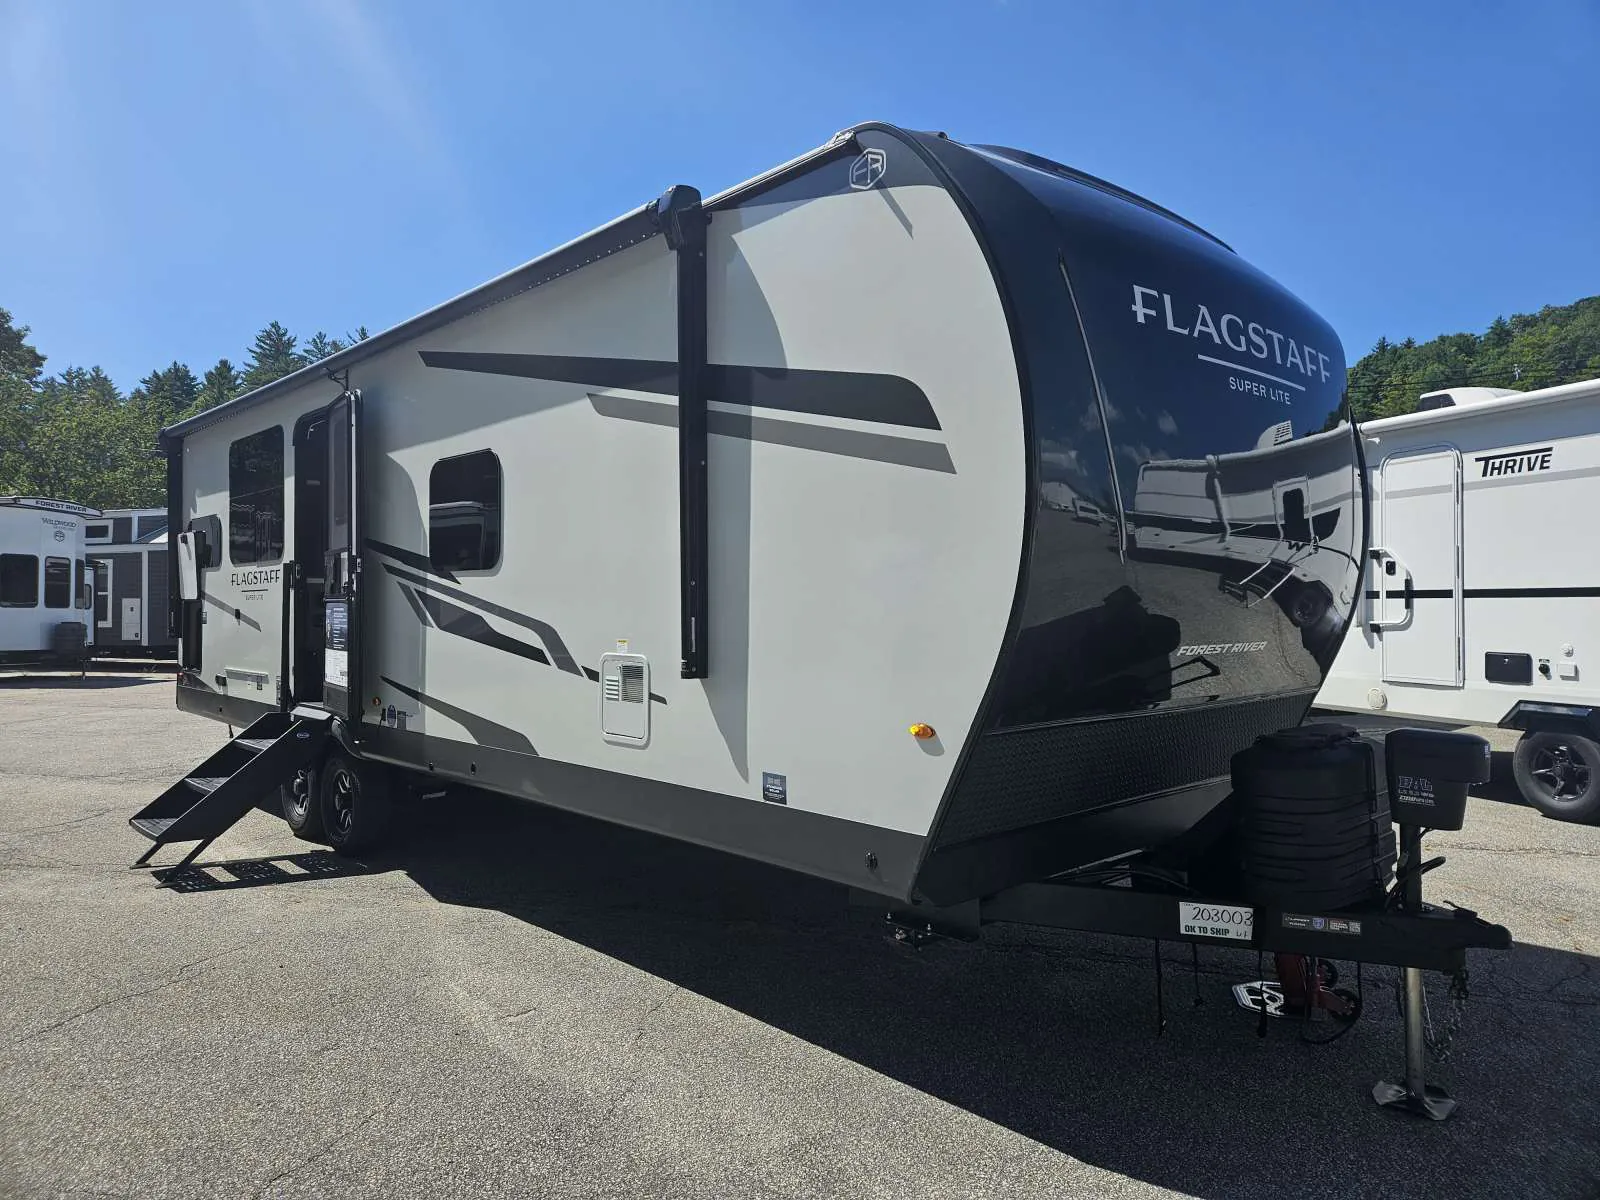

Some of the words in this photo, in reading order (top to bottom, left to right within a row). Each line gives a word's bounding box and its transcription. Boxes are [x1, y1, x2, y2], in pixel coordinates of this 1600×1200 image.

[1132, 284, 1331, 383] FLAGSTAFF
[1229, 376, 1267, 399] SUPER
[1270, 387, 1291, 405] LITE
[1474, 446, 1554, 478] THRIVE
[36, 500, 64, 509] FOREST
[65, 504, 87, 512] RIVER
[231, 569, 281, 586] FLAGSTAFF
[1176, 643, 1233, 657] FOREST
[1230, 641, 1268, 653] RIVER
[1192, 906, 1254, 927] 203003
[1184, 924, 1196, 934] OK
[1197, 925, 1208, 935] TO
[1210, 927, 1230, 937] SHIP
